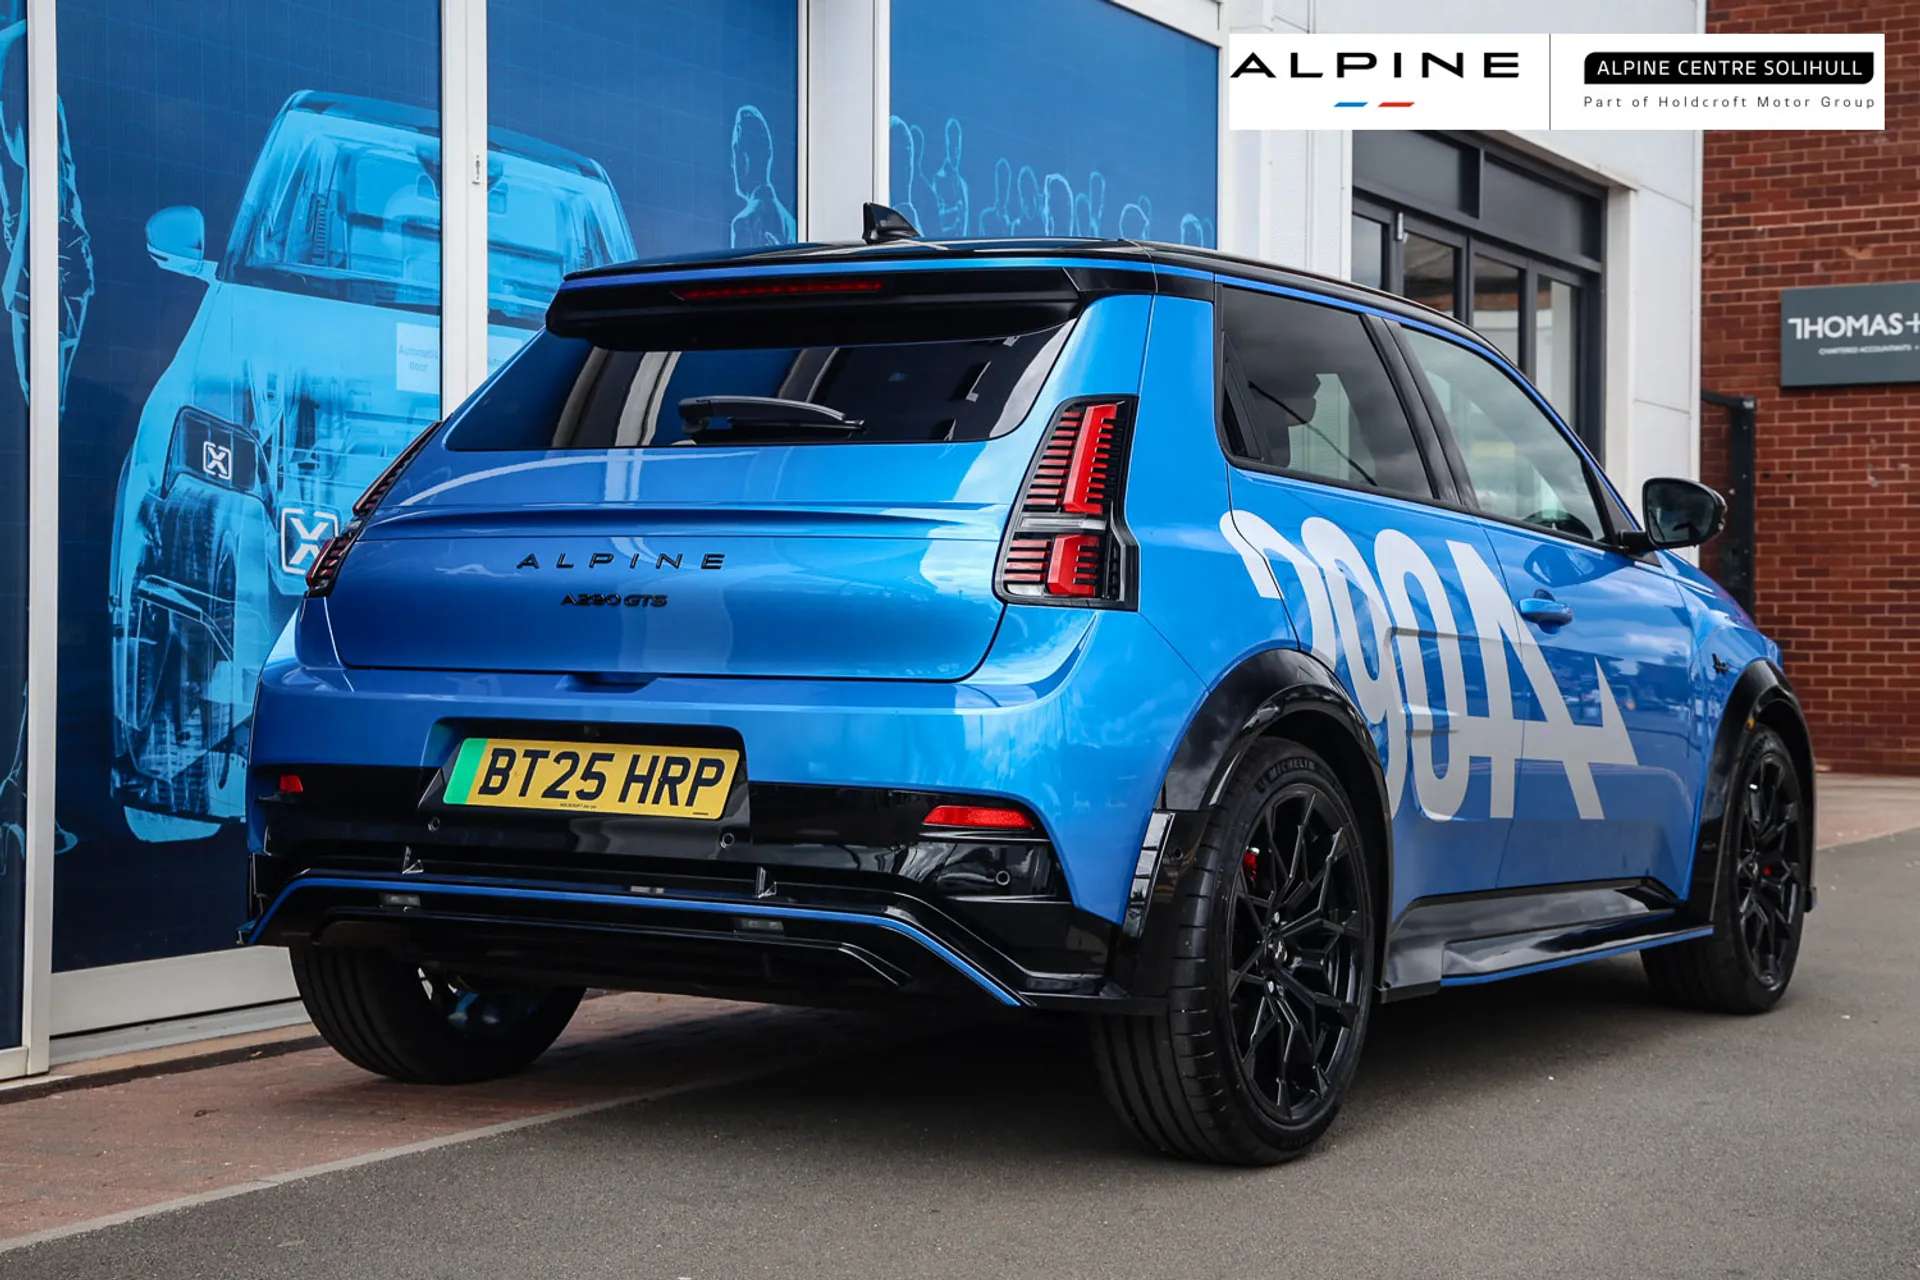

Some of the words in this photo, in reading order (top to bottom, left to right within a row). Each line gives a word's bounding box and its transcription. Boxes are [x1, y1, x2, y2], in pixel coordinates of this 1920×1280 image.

[516, 553, 725, 570] ALPINE
[478, 747, 616, 801] BT25
[618, 754, 725, 807] HRP
